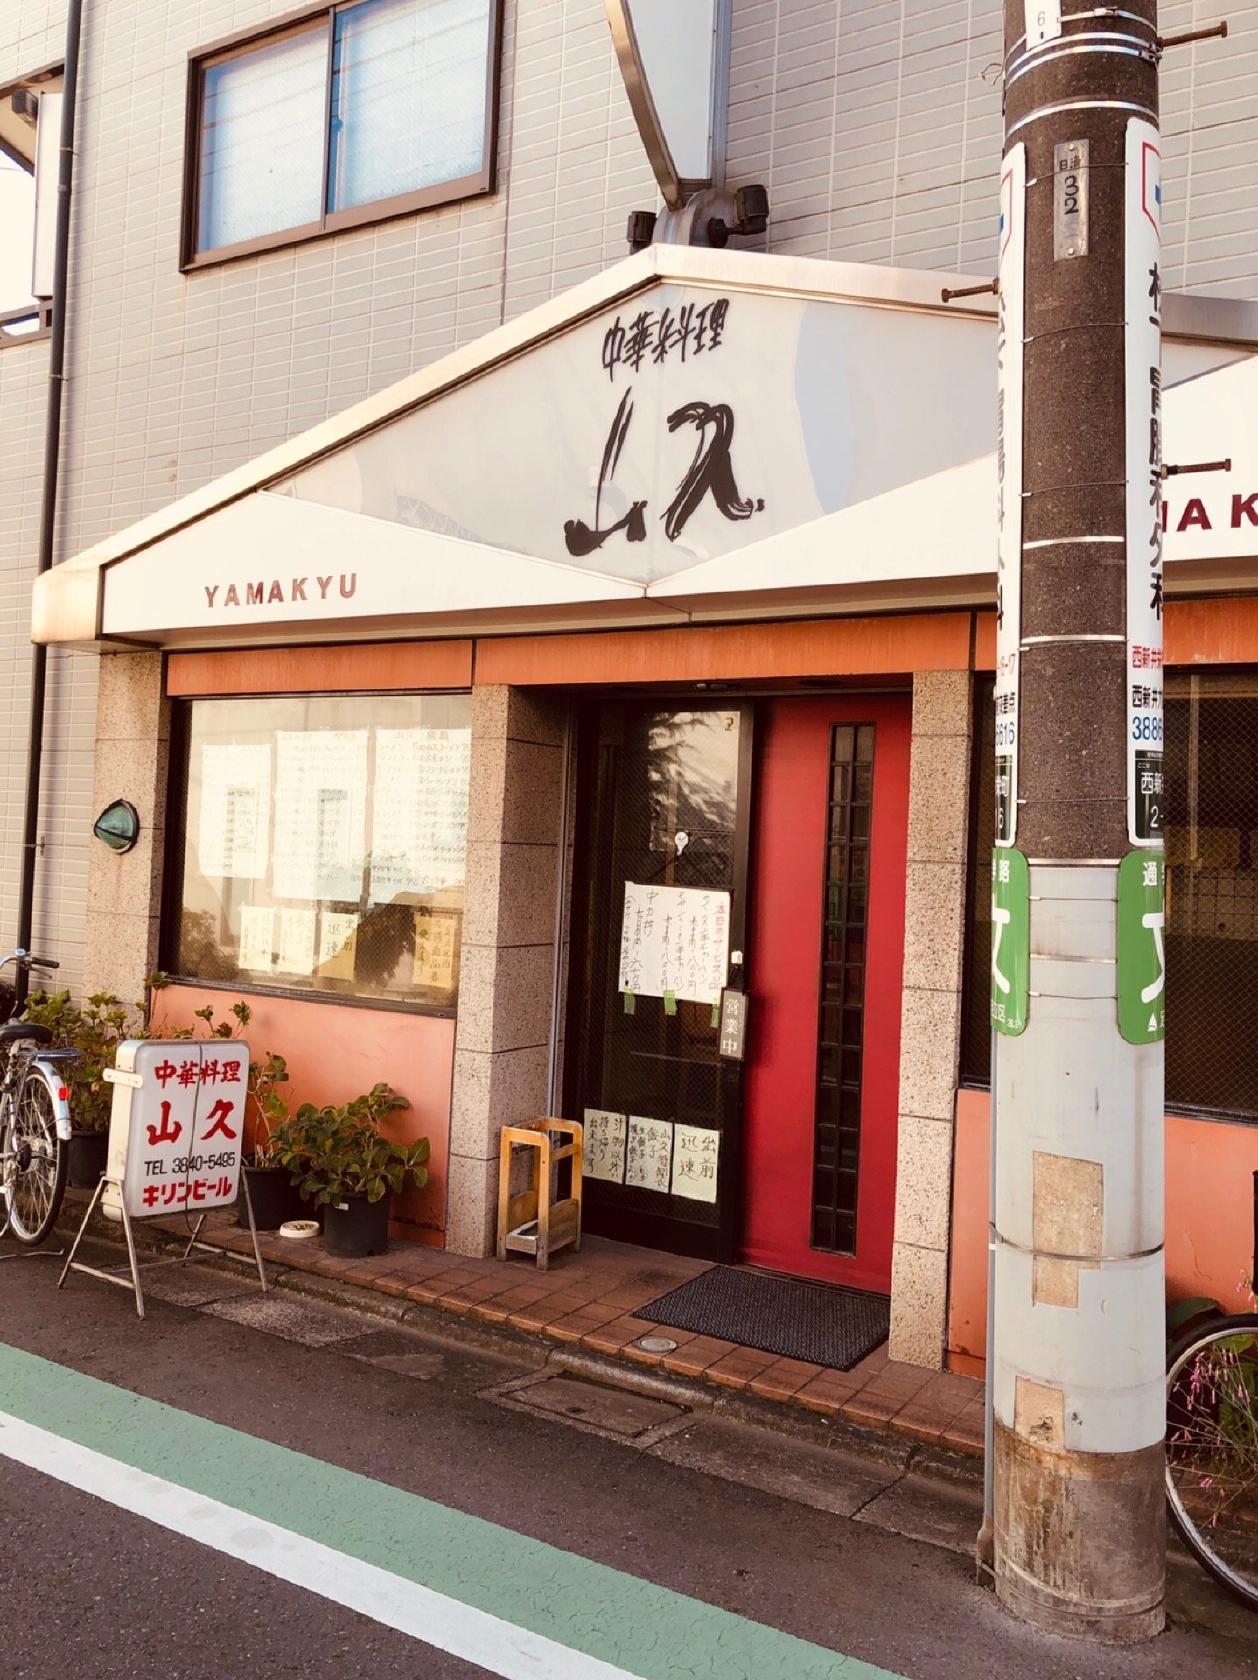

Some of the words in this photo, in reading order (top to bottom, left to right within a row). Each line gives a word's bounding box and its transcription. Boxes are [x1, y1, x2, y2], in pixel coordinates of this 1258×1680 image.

[602, 298, 730, 383] 中華料理
[1161, 493, 1258, 534] AK
[204, 573, 357, 609] YAMAKYU
[154, 1059, 241, 1089] 中華料理
[146, 1098, 237, 1146] 山久
[144, 1160, 167, 1177] TEL
[172, 1152, 236, 1174] 3840-5495
[143, 1176, 233, 1208] キリンビール
